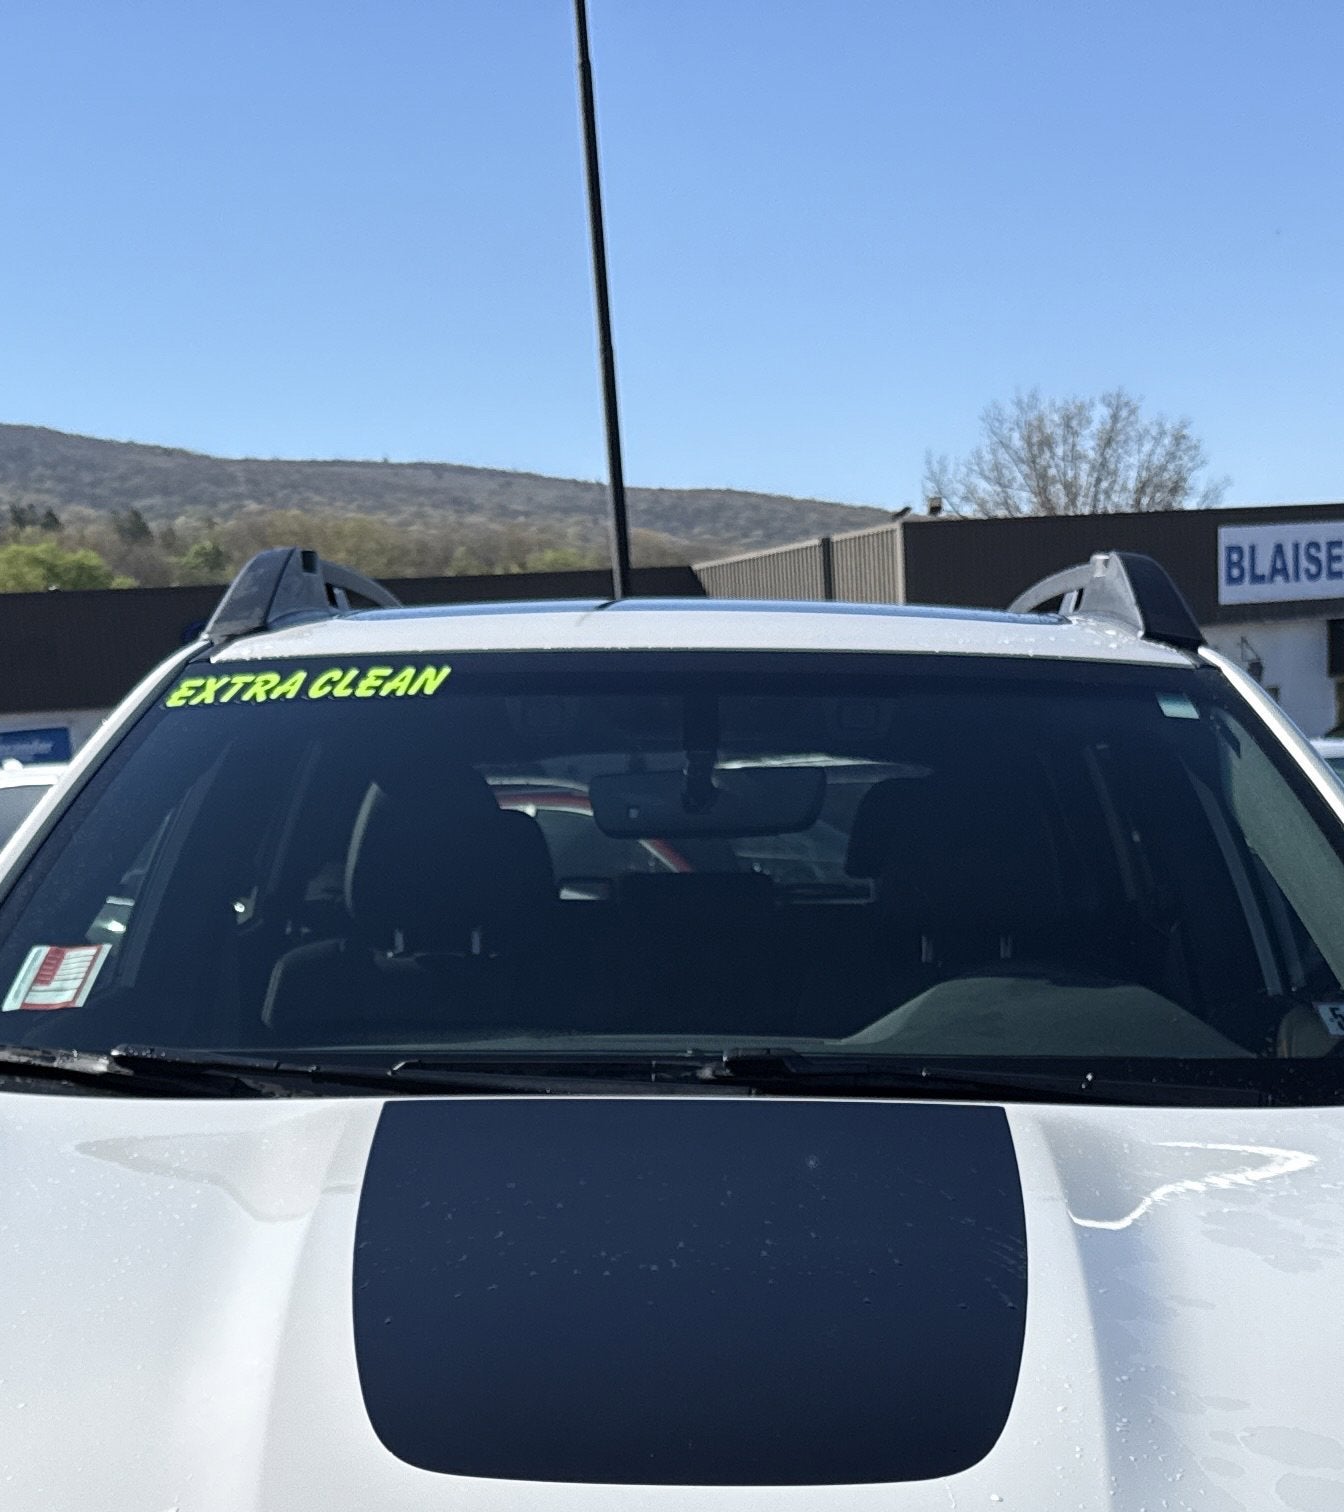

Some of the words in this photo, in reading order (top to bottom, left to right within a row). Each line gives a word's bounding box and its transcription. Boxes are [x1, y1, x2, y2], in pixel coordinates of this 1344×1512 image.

[1224, 540, 1344, 586] BLAISE
[165, 670, 307, 708] EXTRA
[307, 665, 452, 699] CLEAN
